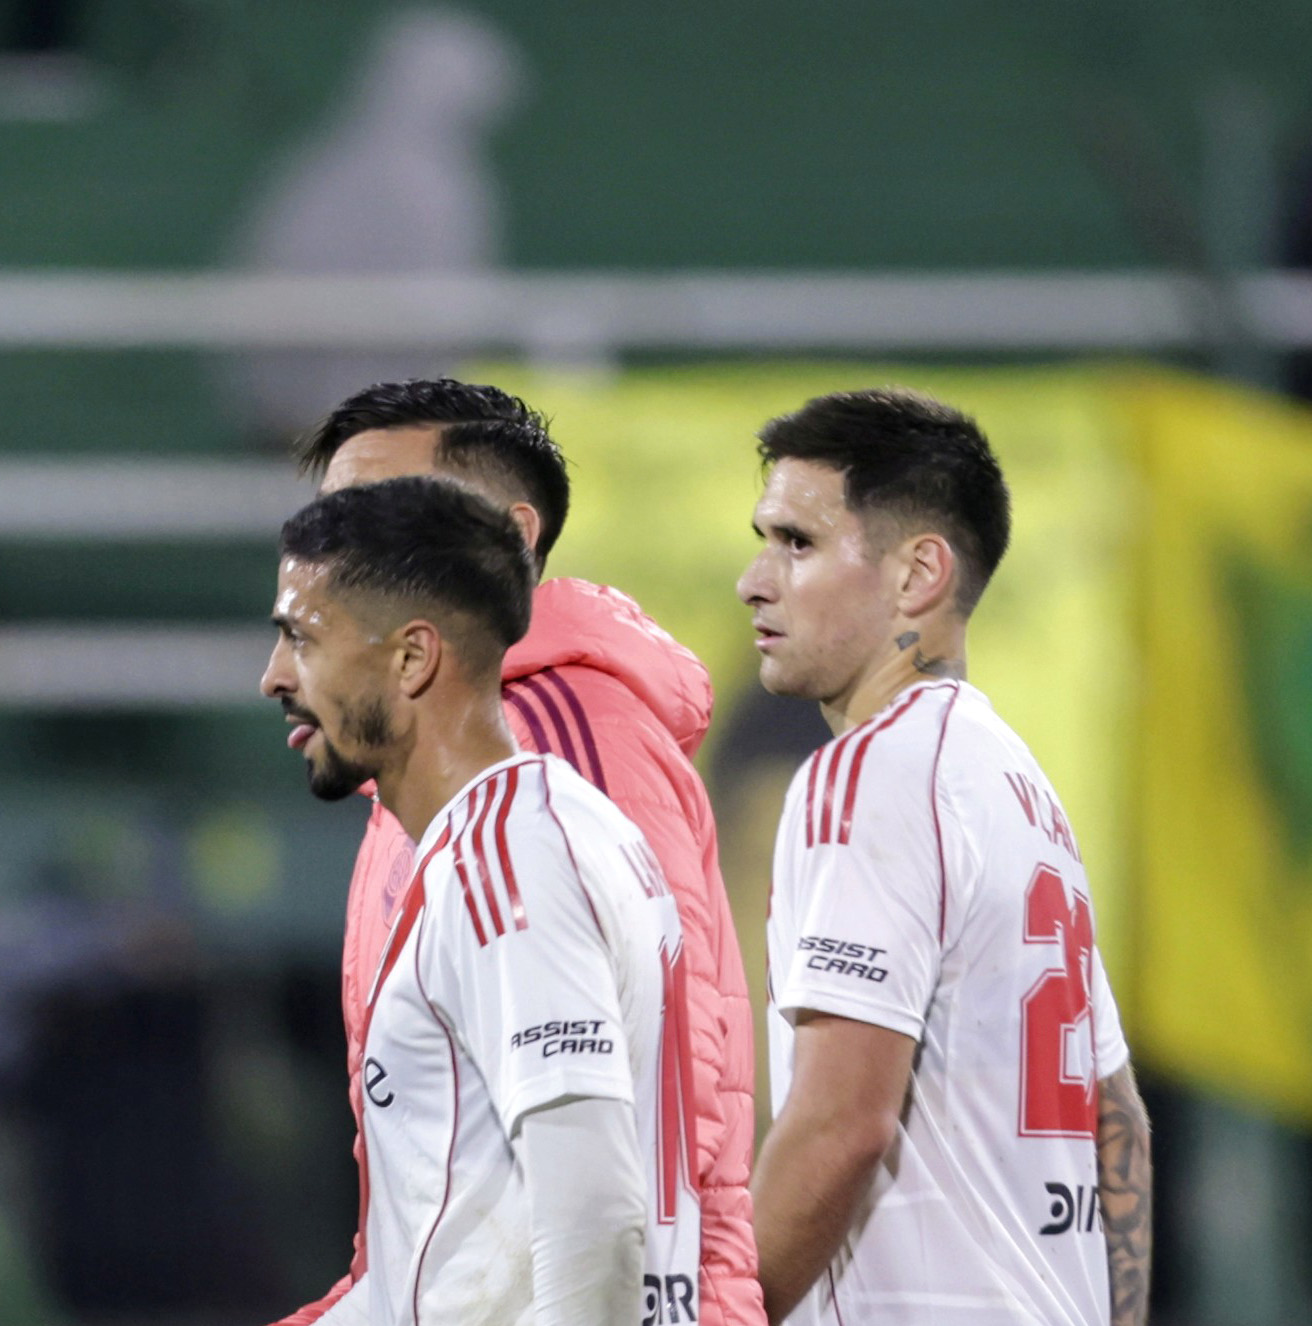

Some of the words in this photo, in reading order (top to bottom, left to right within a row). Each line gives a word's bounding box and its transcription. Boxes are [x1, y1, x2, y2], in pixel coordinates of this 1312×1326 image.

[807, 955, 889, 983] CARD
[511, 1020, 606, 1052] ASSIST
[542, 1039, 614, 1058] CARD
